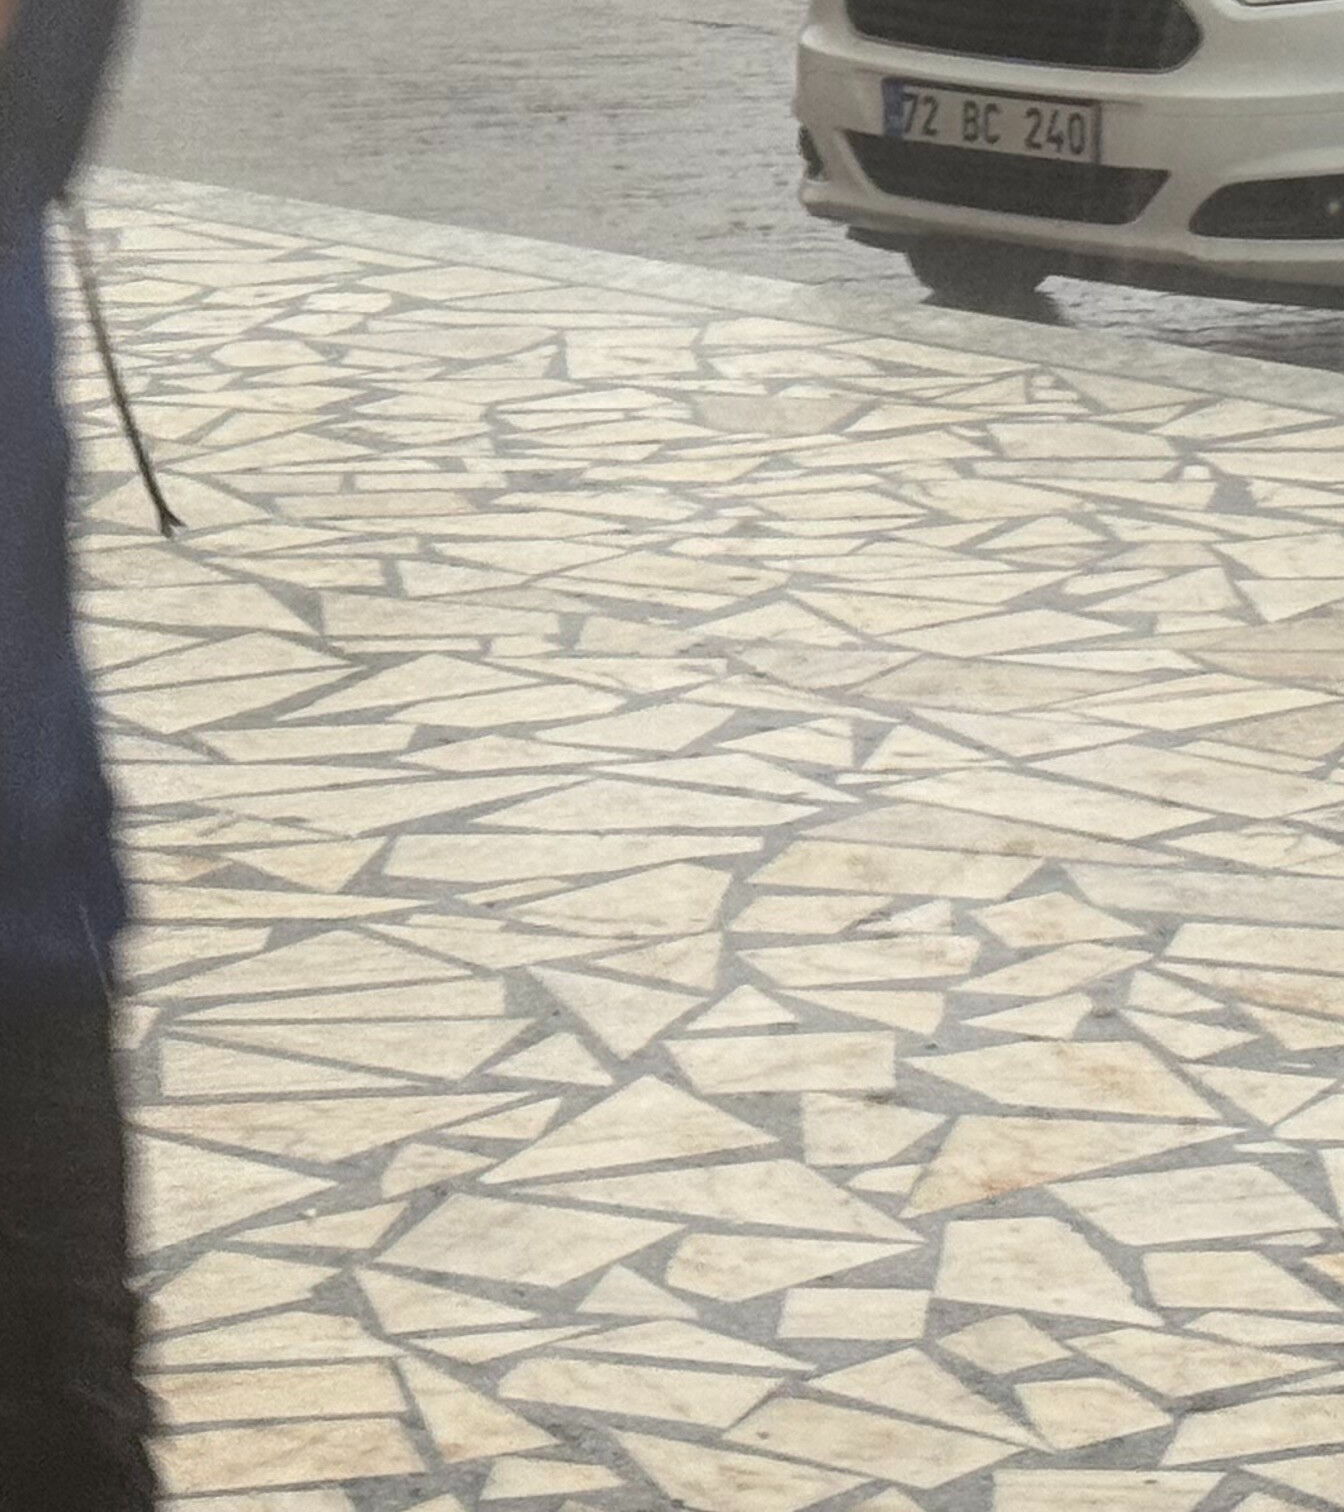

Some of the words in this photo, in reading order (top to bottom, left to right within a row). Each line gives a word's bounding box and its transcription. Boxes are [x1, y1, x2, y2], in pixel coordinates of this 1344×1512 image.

[901, 91, 940, 137] 72
[961, 99, 1003, 145] BC
[1024, 106, 1087, 156] 240
